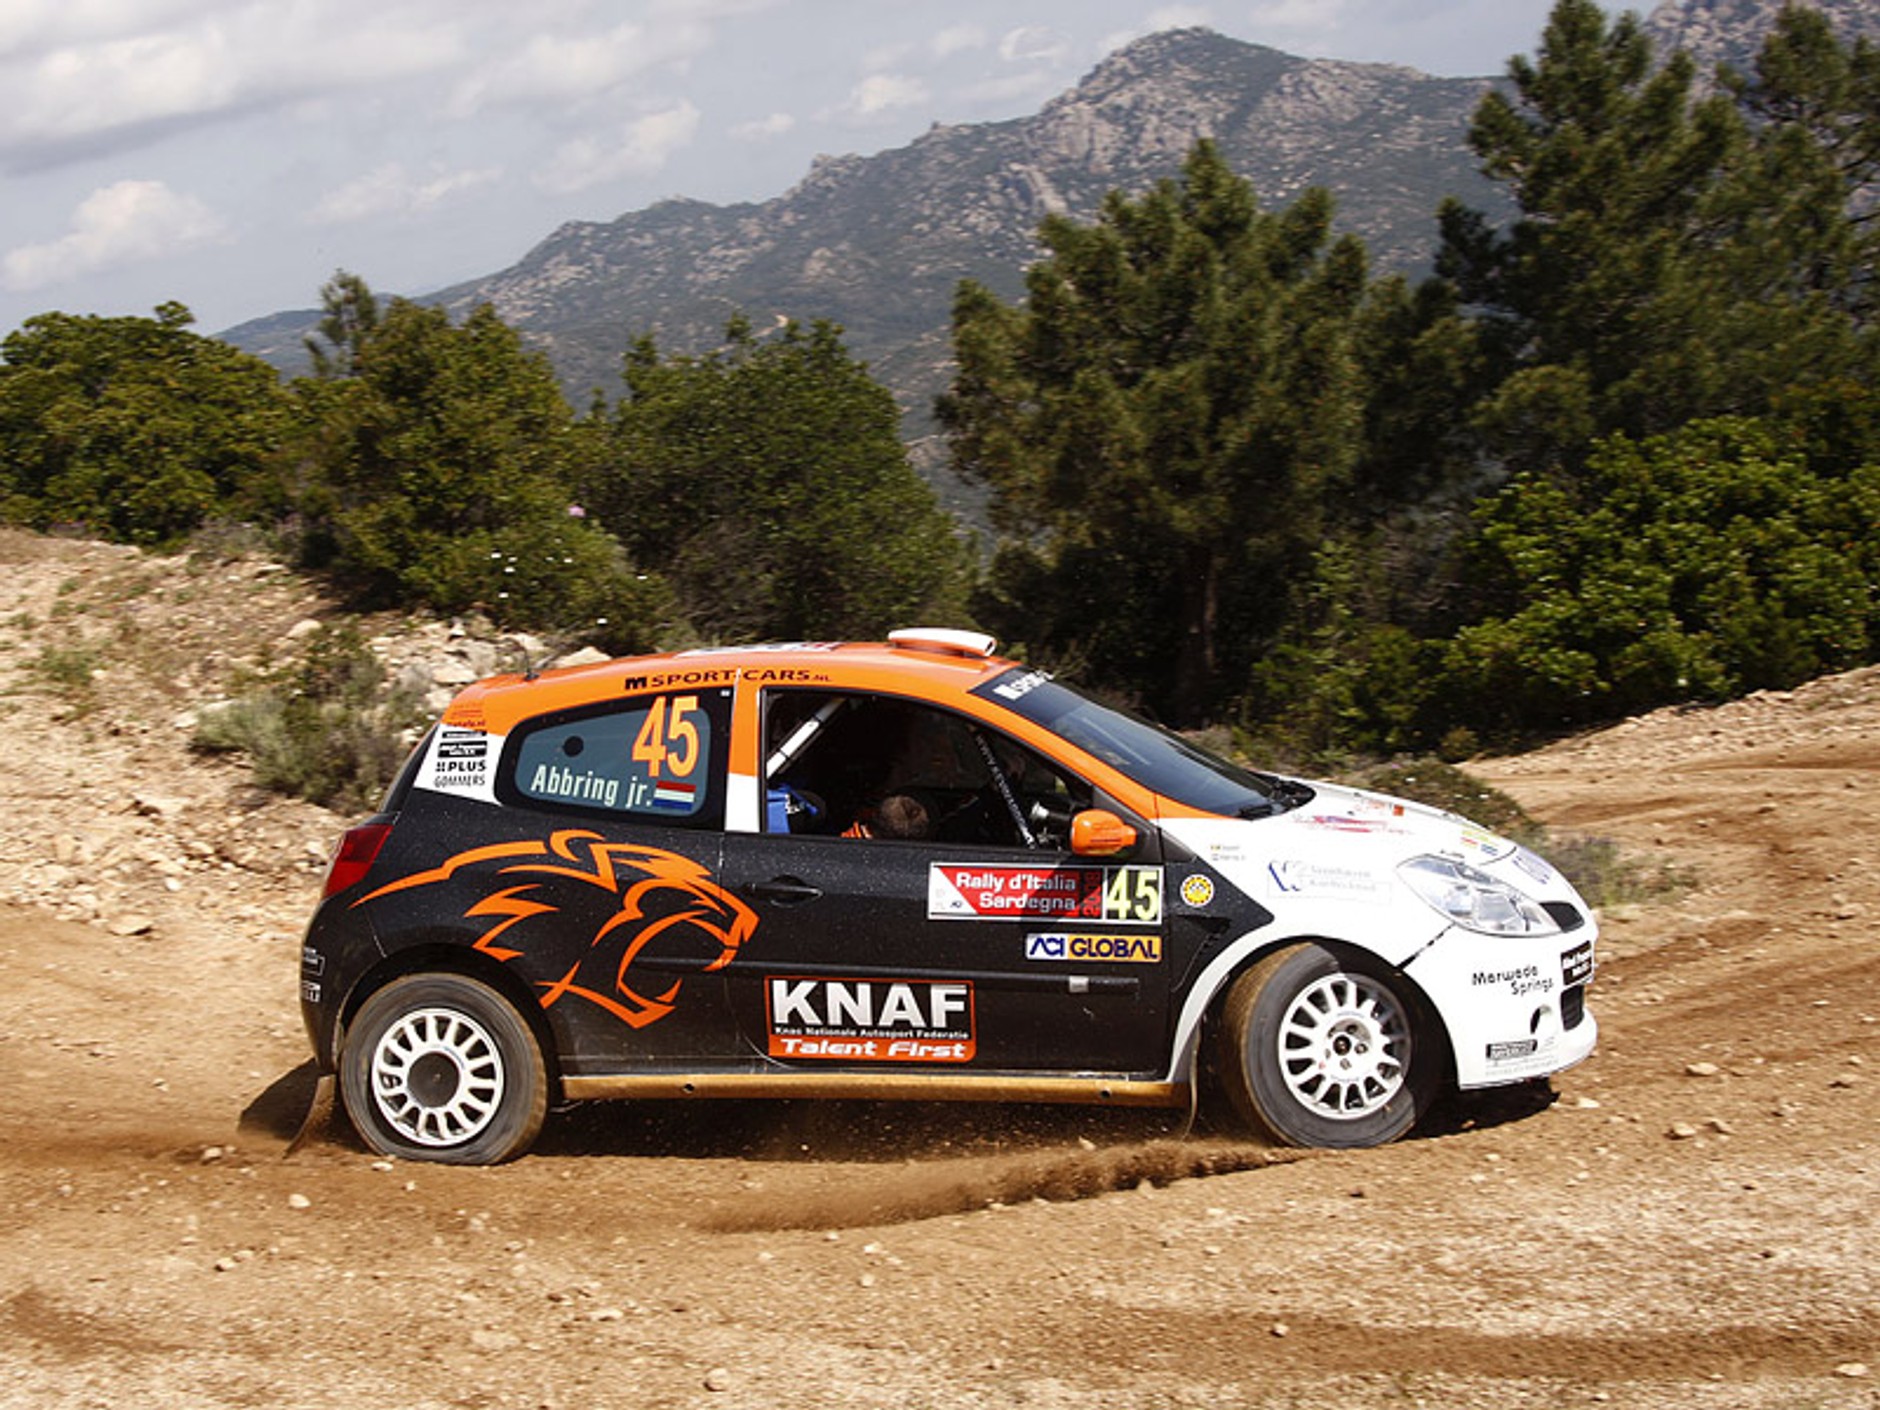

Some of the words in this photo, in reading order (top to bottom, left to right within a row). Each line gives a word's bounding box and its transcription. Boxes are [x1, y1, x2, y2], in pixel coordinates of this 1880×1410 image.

[631, 695, 700, 777] 45
[448, 760, 486, 772] PLUS
[530, 763, 619, 807] Abbring
[625, 775, 653, 809] jr.
[956, 872, 1003, 892] Rally
[1009, 873, 1076, 891] d'Italia
[980, 892, 1076, 912] Sardegna
[1106, 868, 1158, 920] 45
[1070, 937, 1158, 959] GLOBAL
[772, 979, 967, 1028] KNAF
[805, 1027, 857, 1037] Nationale
[859, 1029, 914, 1040] Autosport
[916, 1030, 969, 1040] Federatie
[780, 1039, 876, 1056] Talent
[888, 1041, 966, 1058] First
